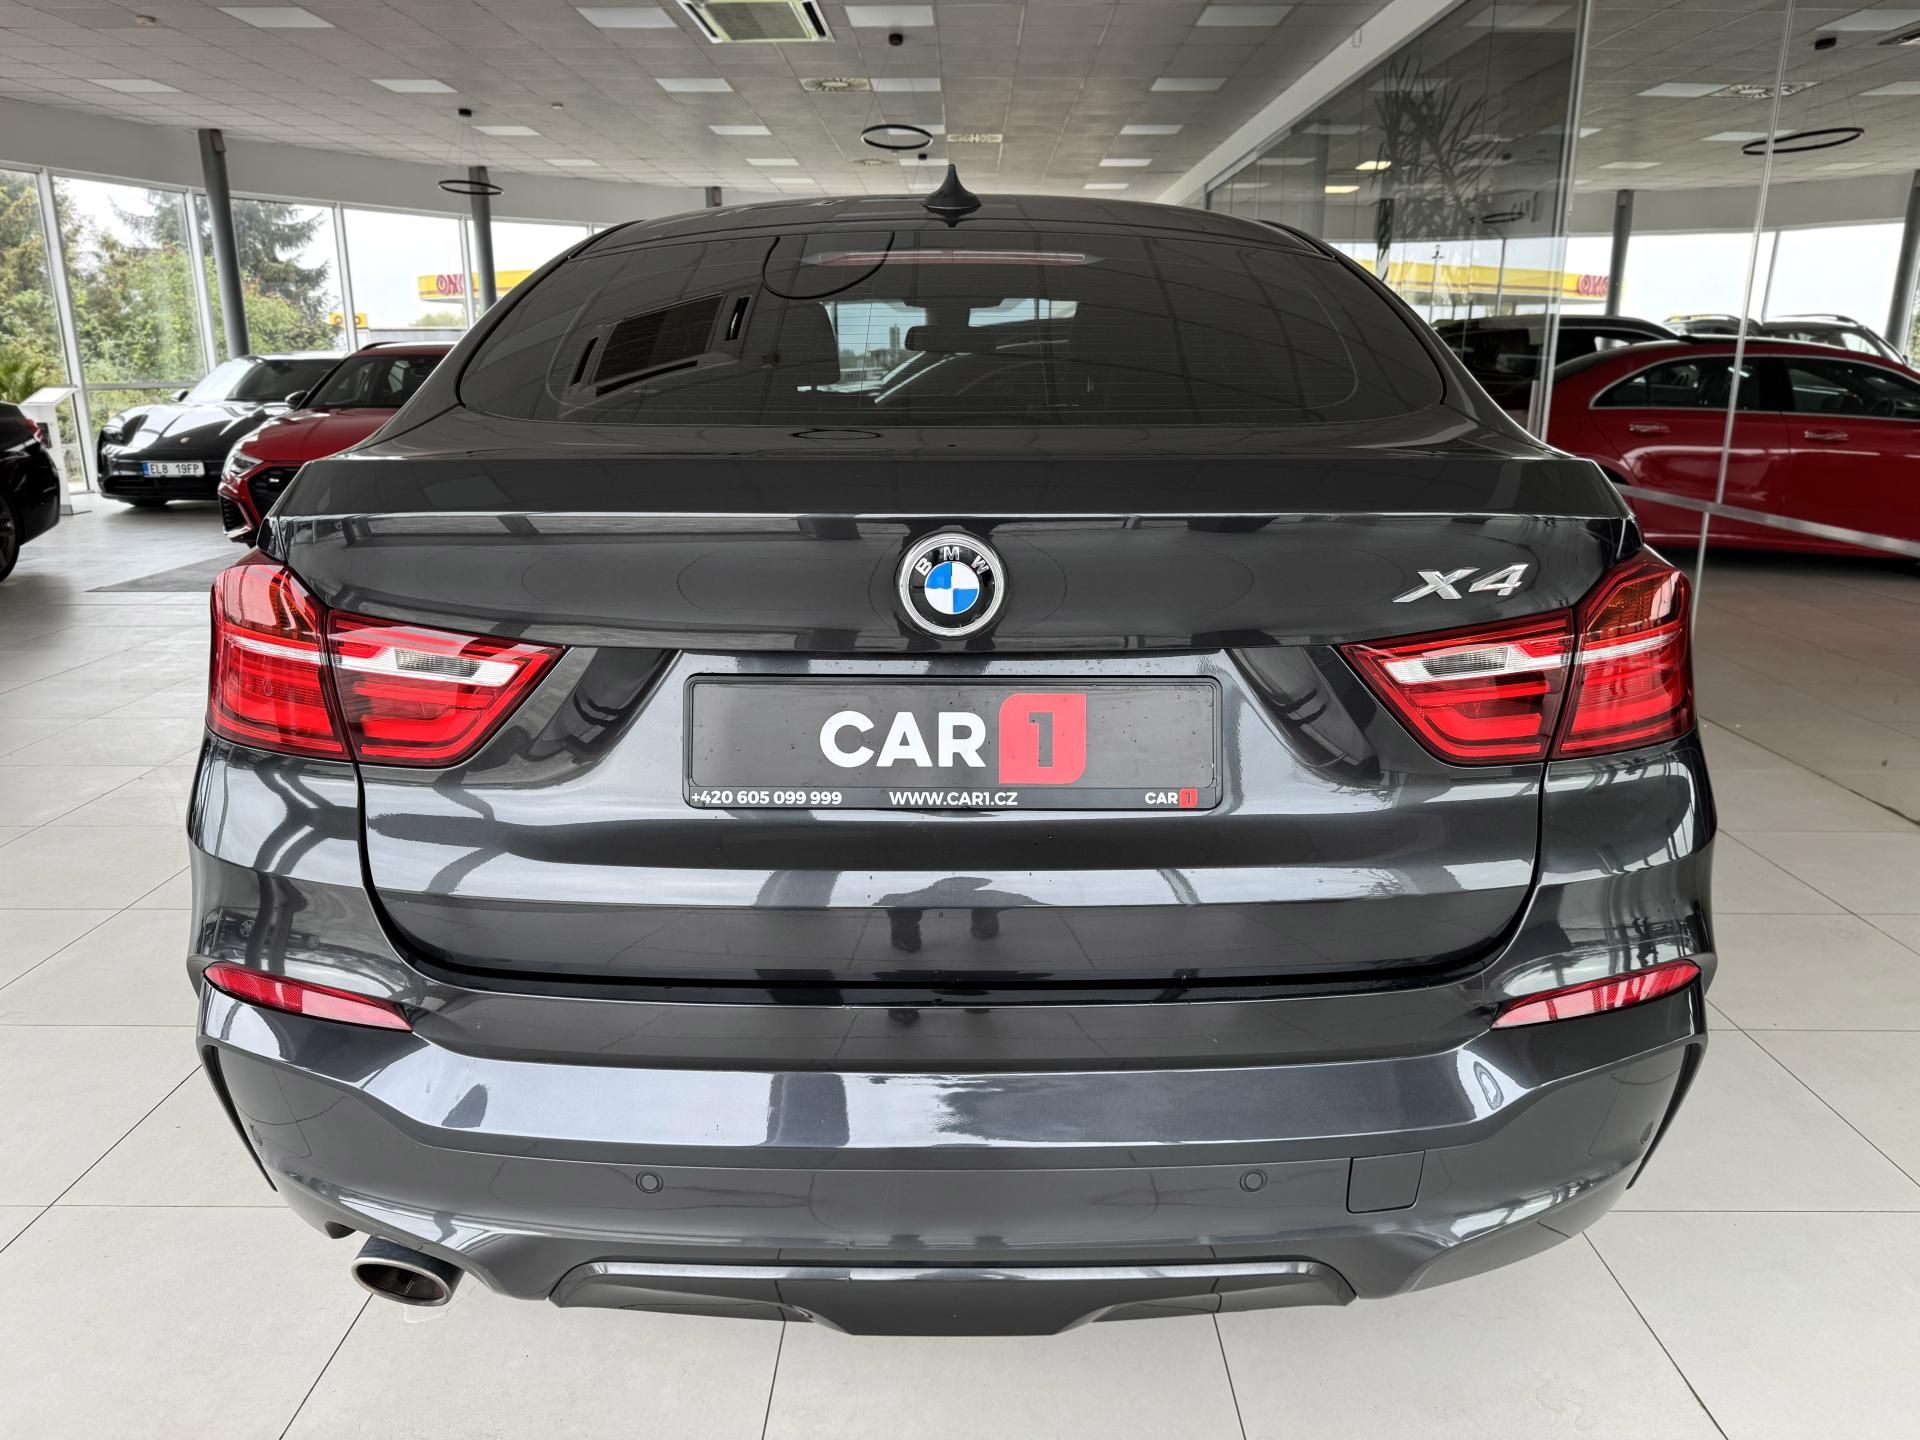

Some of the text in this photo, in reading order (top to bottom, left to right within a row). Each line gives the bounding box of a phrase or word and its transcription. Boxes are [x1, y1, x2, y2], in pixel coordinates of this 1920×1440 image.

[175, 463, 200, 475] 19FP
[914, 546, 990, 577] BMW
[1391, 563, 1529, 603] X4
[819, 710, 987, 768] CAR
[691, 790, 843, 805] +420 605 099 999
[888, 791, 1018, 806] WWW.CAR1.CZ
[1144, 791, 1179, 805] CAR
